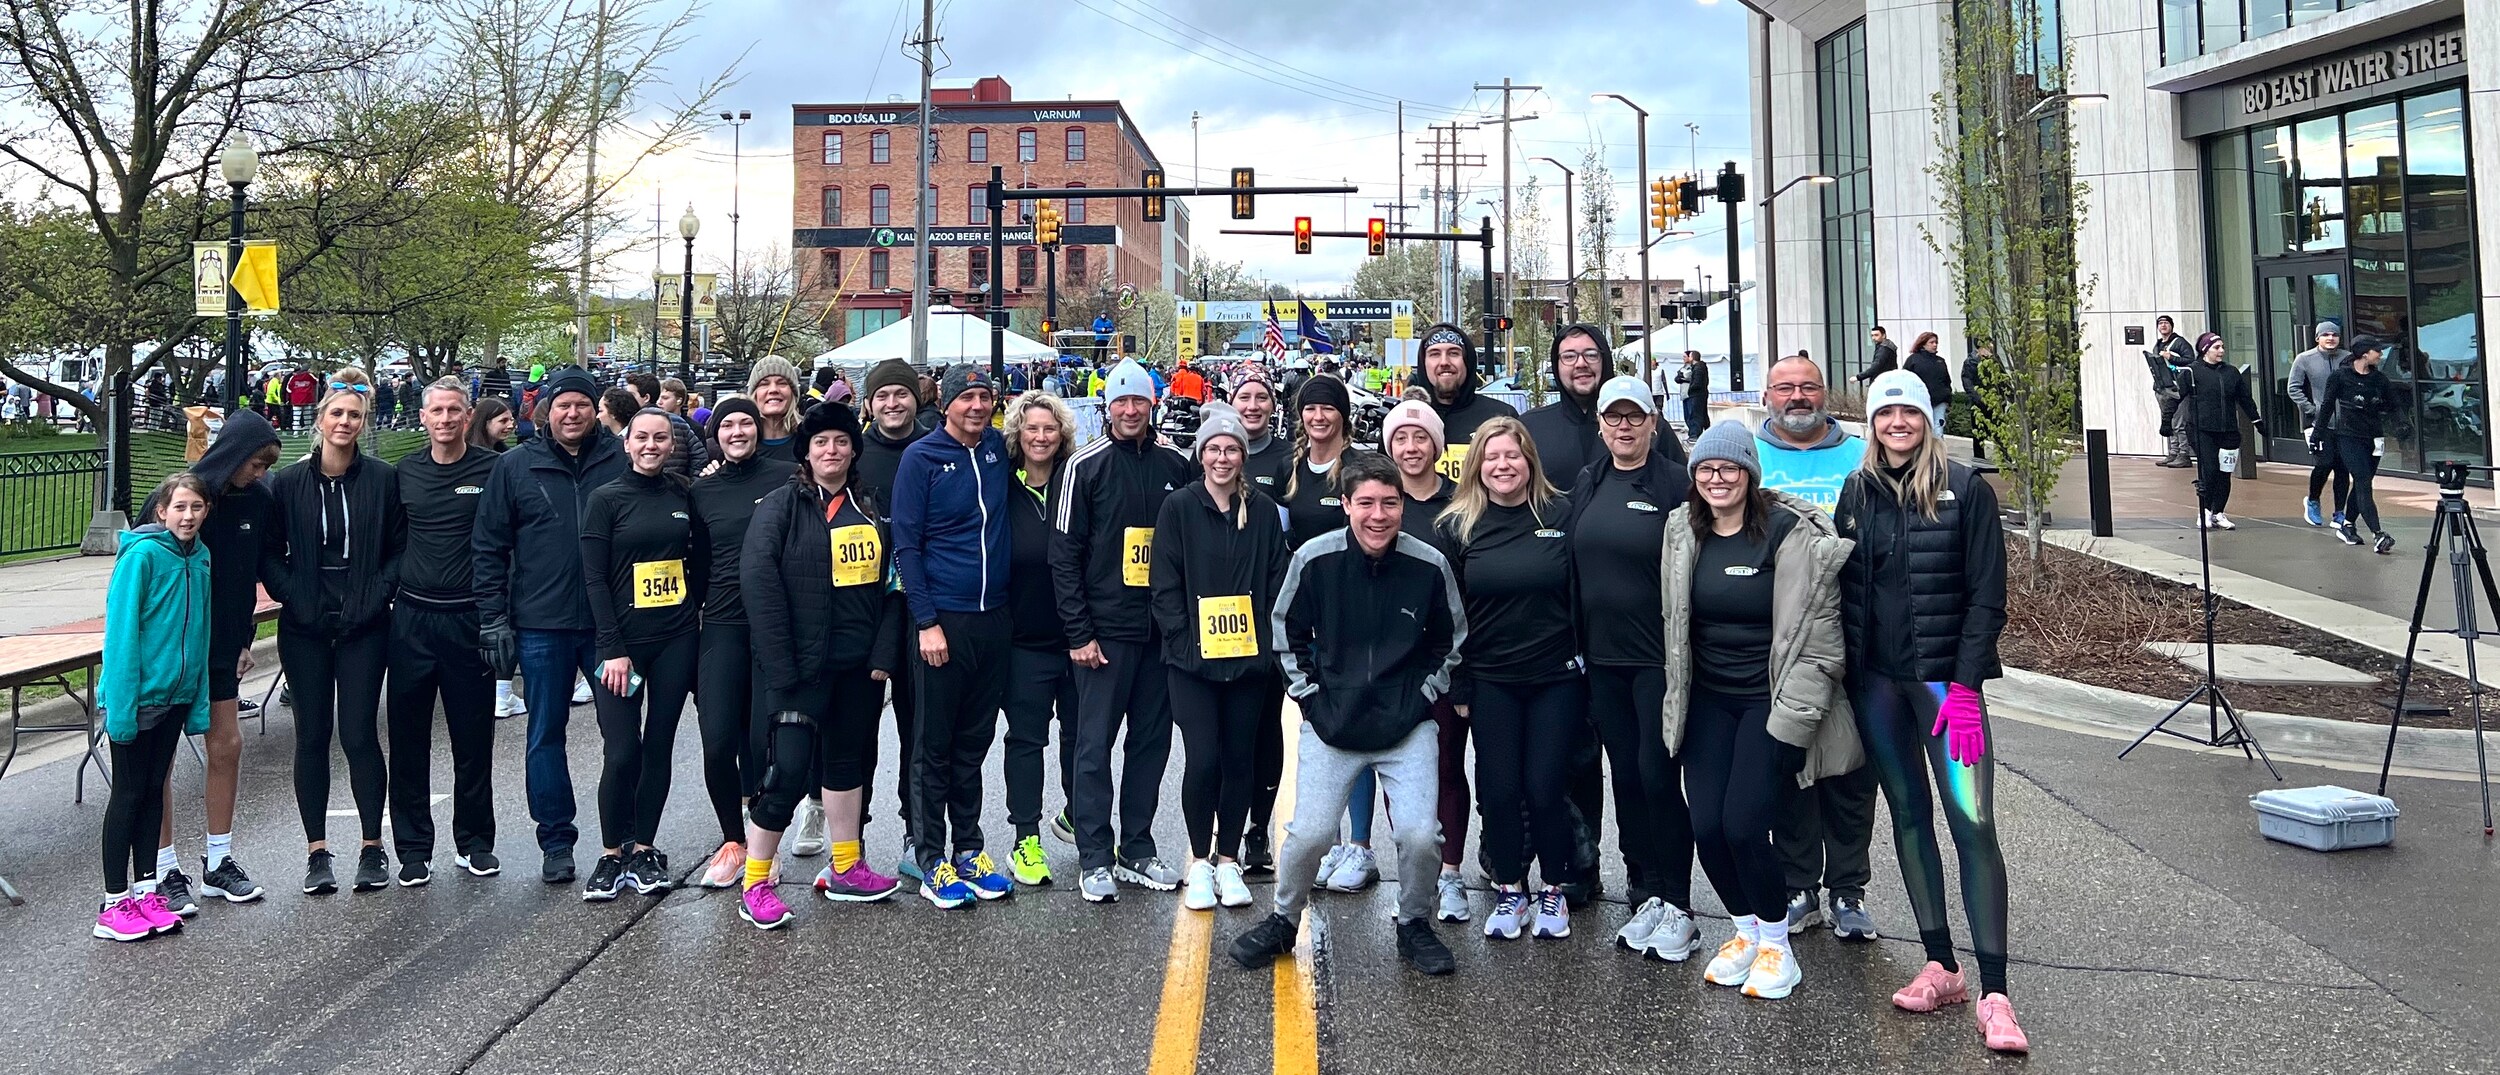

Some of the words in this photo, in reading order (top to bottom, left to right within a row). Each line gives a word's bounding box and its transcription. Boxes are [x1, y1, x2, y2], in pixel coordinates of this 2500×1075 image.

[2272, 69, 2314, 107] EAST
[2319, 51, 2390, 94] WATER
[828, 114, 852, 124] BDO
[854, 113, 879, 125] USA,
[879, 113, 897, 123] LLP
[1033, 109, 1081, 122] VARNUM
[896, 232, 954, 242] KALAZOO
[956, 232, 981, 241] BEER
[983, 231, 1034, 241] EHANGE
[1216, 311, 1252, 320] ZEIGLER
[1328, 307, 1390, 315] MARATHON
[839, 541, 876, 564] 3013
[1131, 544, 1151, 564] 30
[642, 576, 679, 597] 3544
[1207, 612, 1248, 635] 3009
